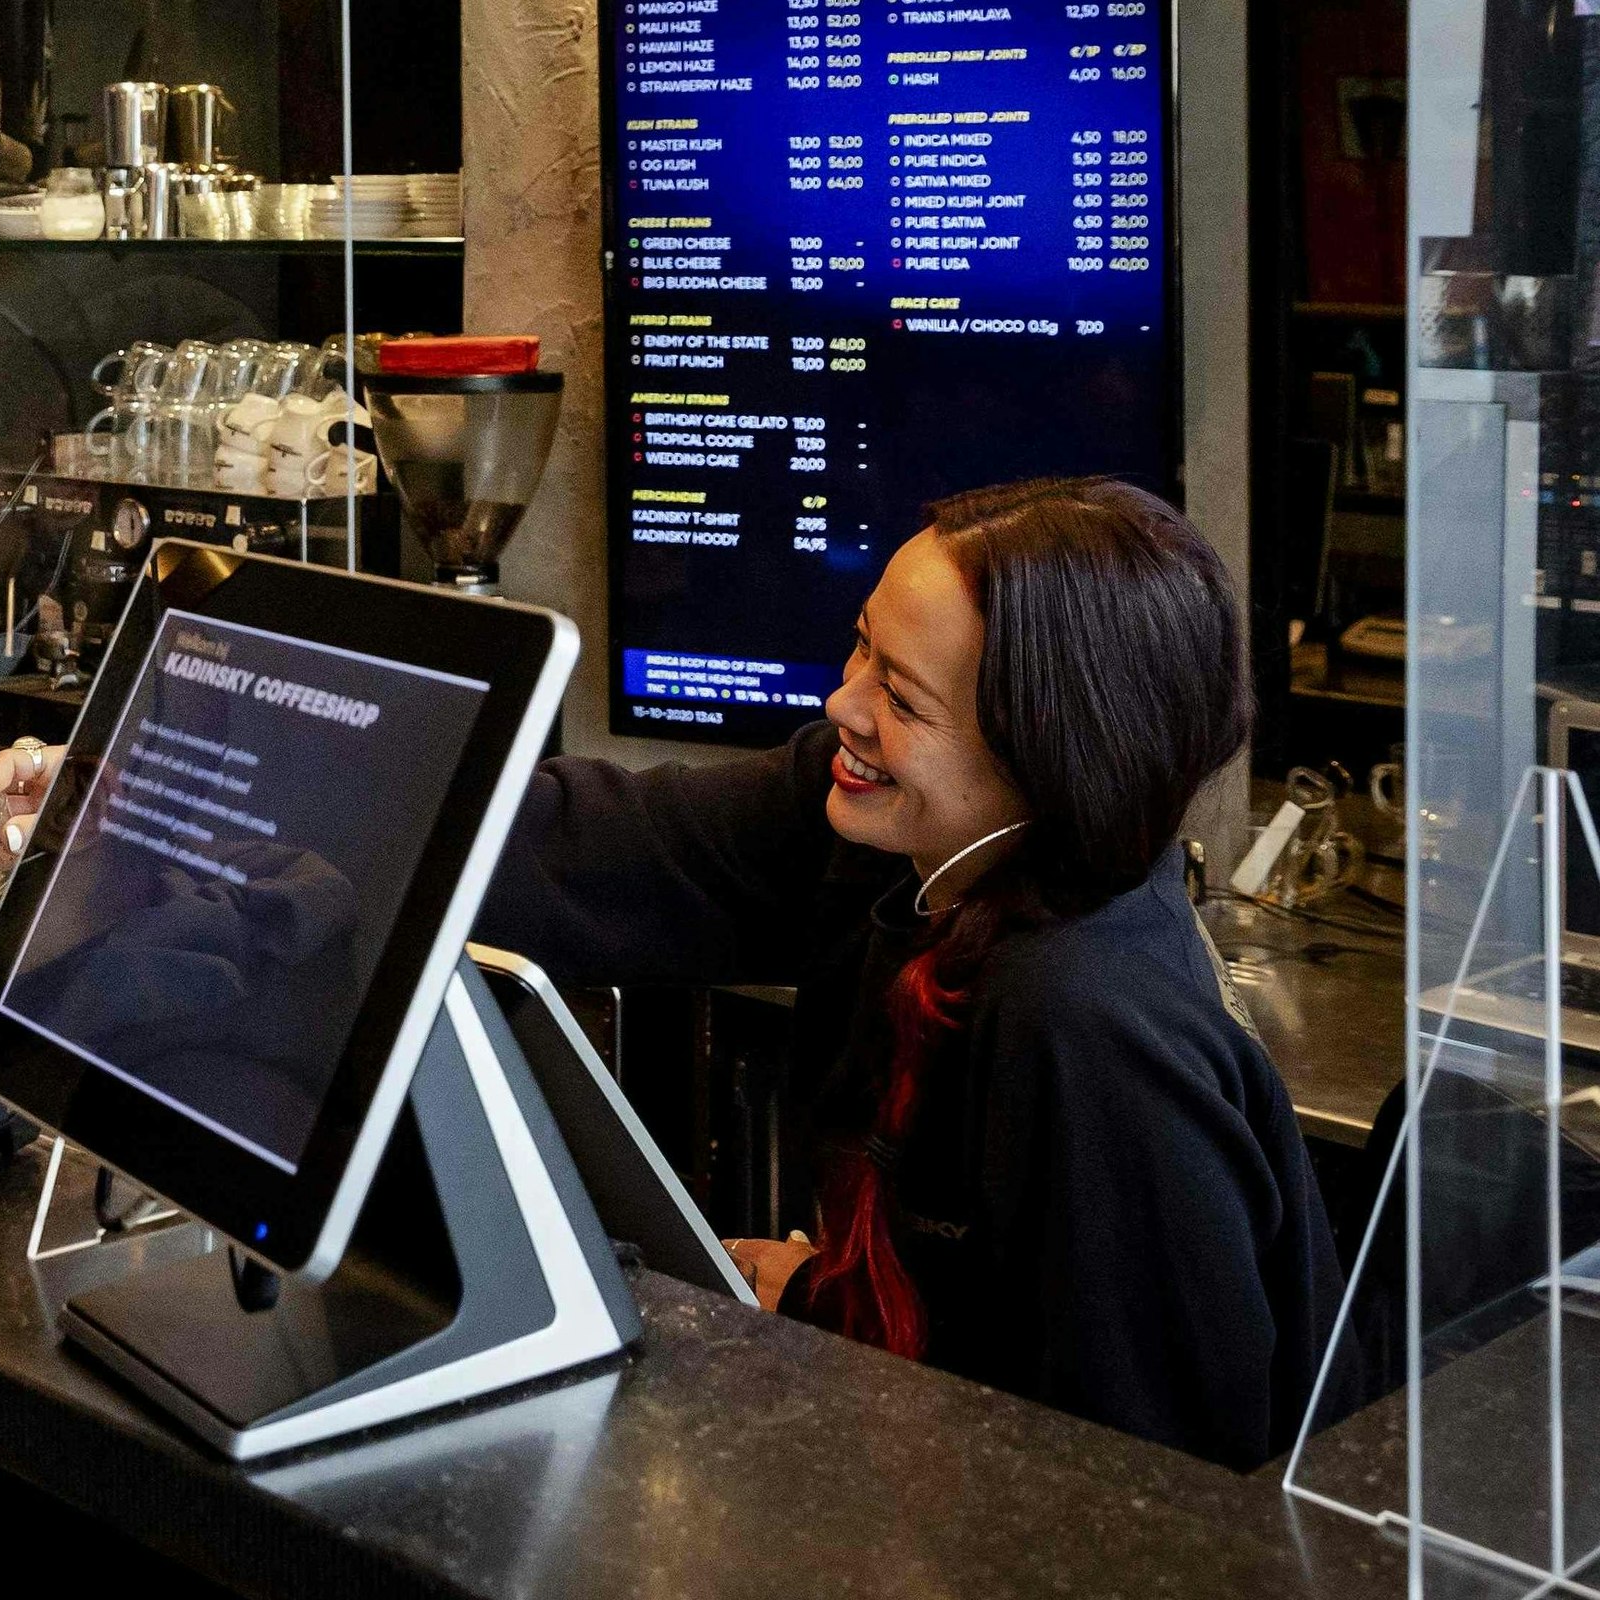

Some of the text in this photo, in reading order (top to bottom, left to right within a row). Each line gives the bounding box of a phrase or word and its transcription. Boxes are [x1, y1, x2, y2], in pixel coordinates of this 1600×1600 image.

[638, 1, 718, 14] MANGO HAZE
[1065, 3, 1145, 19] 12,50 50,00
[902, 8, 1011, 23] TRANS HIMALAYA
[639, 20, 701, 34] MAUI HAZE
[787, 16, 818, 29] 13,00
[639, 40, 714, 53] HAWAII HAZE
[788, 37, 819, 49] 13,50
[887, 52, 951, 63] PREROLLED
[985, 49, 1027, 60] JOINTS
[639, 60, 715, 74] LEMON HAZE
[787, 57, 819, 69] 14,00
[903, 73, 939, 84] HASH
[1069, 68, 1100, 82] 4,00
[640, 78, 752, 93] STRAWBERRY HAZE
[787, 77, 820, 90] 14,00
[655, 119, 698, 129] STRAINS
[888, 114, 952, 125] PREROLLED
[989, 112, 1030, 123] JOINTS
[789, 136, 821, 149] 13,00
[904, 134, 992, 146] INDICA MIXED
[1071, 131, 1101, 144] 4,50
[641, 139, 722, 151] MASTER KUSH
[641, 159, 696, 171] OG KUSH
[904, 155, 986, 167] PURE INDICA
[1072, 152, 1147, 165] 5,50 22,00
[642, 179, 709, 191] TUNA KUSH
[905, 175, 991, 187] SATIVA MIXED
[1072, 173, 1148, 187] 5,50 22,00
[905, 195, 1026, 208] MIXED KUSH JOINT
[1073, 195, 1102, 208] 6,50
[628, 218, 711, 228] CHEESE STRAINS
[905, 217, 986, 229] PURE SATIVA
[1073, 216, 1102, 229] 6,50
[642, 238, 731, 250] GREEN CHEESE
[790, 237, 822, 251] 10,00
[905, 237, 1020, 249] PURE KUSH JOINT
[1110, 236, 1148, 250] 30,00
[642, 257, 721, 269] BLUE CHEESE
[792, 257, 822, 271] 12,50
[906, 258, 970, 270] PURE USA
[1067, 257, 1149, 271] 10,00 40,00
[643, 277, 767, 289] BIG BUDDHA CHEESE
[791, 277, 822, 291] 15,00
[891, 298, 960, 309] SPACE CAKE
[630, 316, 711, 326] HYBRID STRAINS
[906, 319, 960, 332] VANILLA
[970, 320, 1025, 332] CHOCO
[1076, 321, 1104, 335] 7,00
[644, 336, 769, 349] ENEMY OF THE STATE
[792, 338, 824, 351] 12,00
[644, 355, 724, 368] FRUIT PUNCH
[631, 392, 729, 406] AMERICAN STRAINS
[645, 413, 787, 430] BIRTHDAY CAKE GELATO
[792, 417, 825, 431] 15,00
[646, 432, 754, 448] TROPICAL COOKIE
[646, 452, 739, 467] WEDDING CAKE
[790, 458, 825, 472] 20,00
[633, 510, 740, 526] KADINSKY T-SHIRT
[633, 530, 739, 546] KADINSKY HOODY
[163, 652, 380, 729] KADINSKY COFFEESHOP
